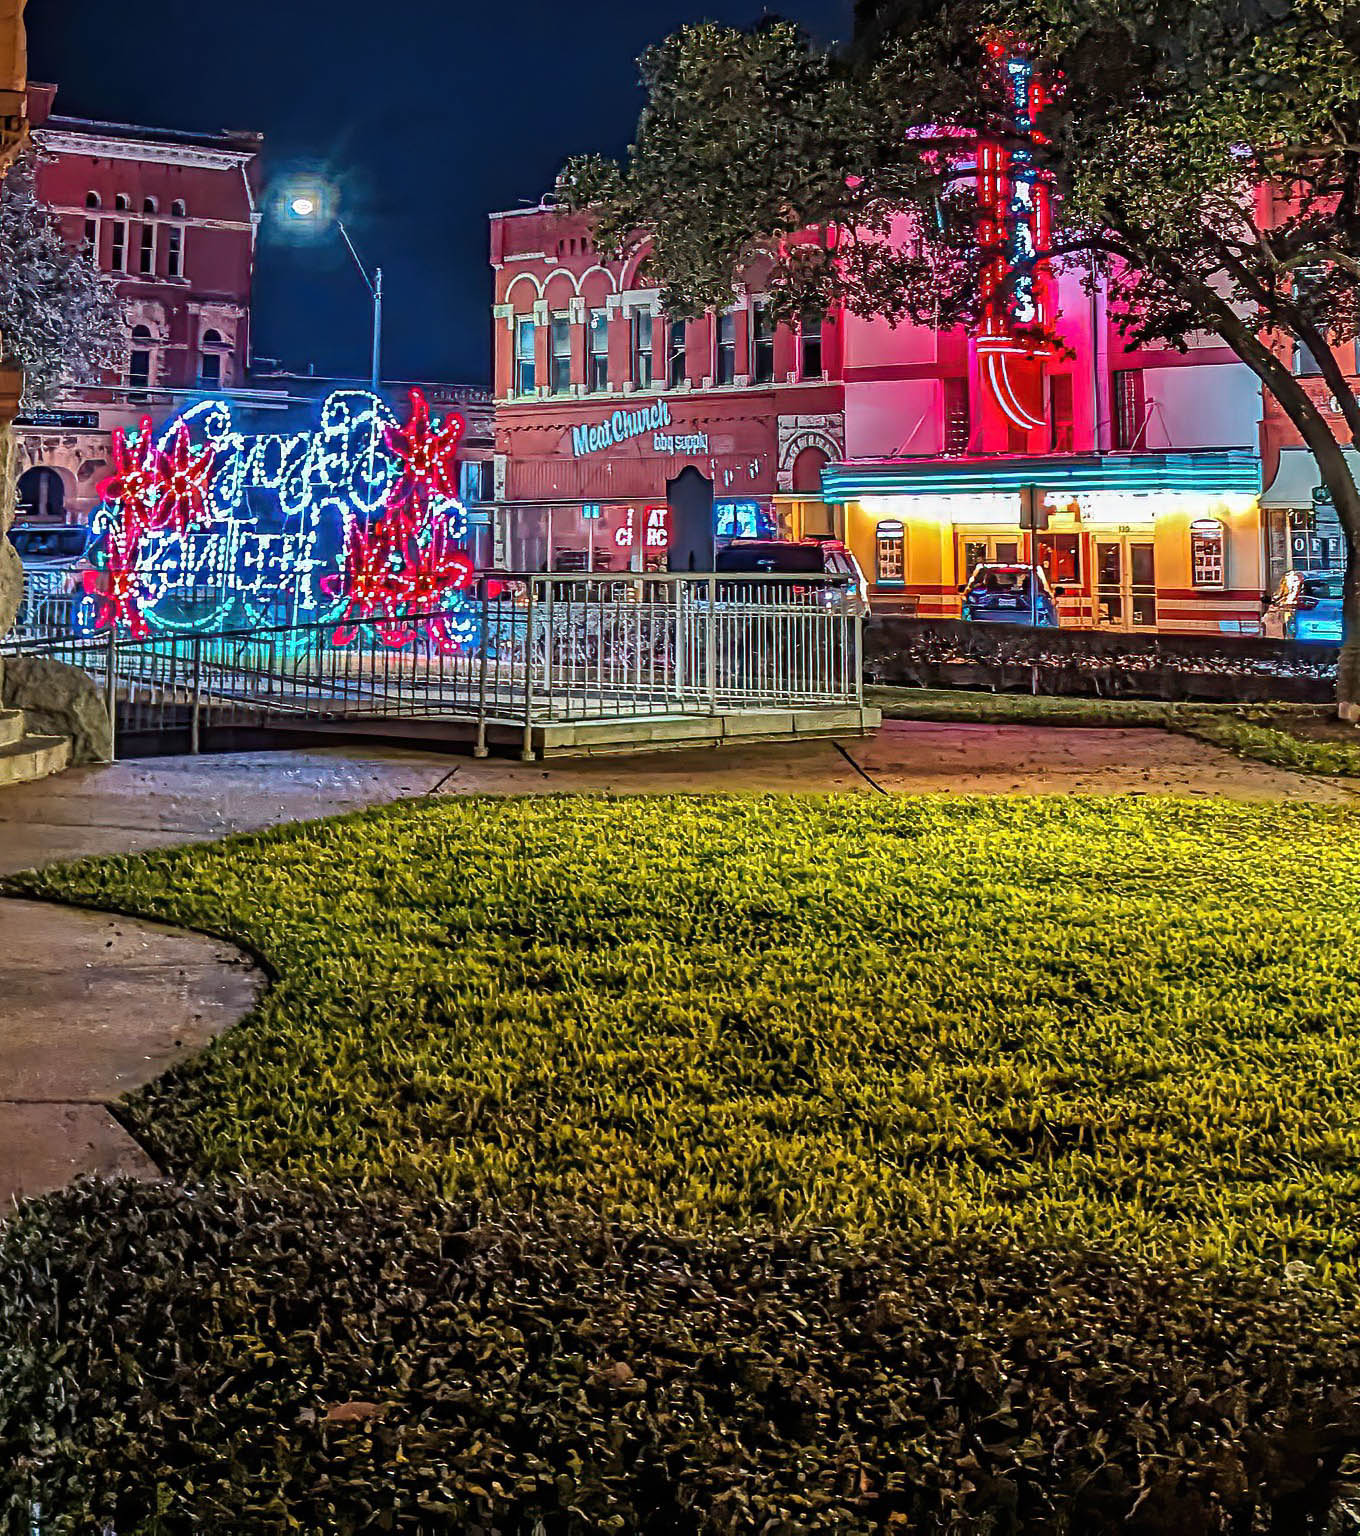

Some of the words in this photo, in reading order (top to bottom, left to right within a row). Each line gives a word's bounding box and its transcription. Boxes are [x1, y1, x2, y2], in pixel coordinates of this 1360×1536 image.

[572, 419, 613, 457] Meat
[611, 398, 672, 443] Church
[653, 432, 675, 456] bbq
[674, 430, 709, 456] supply
